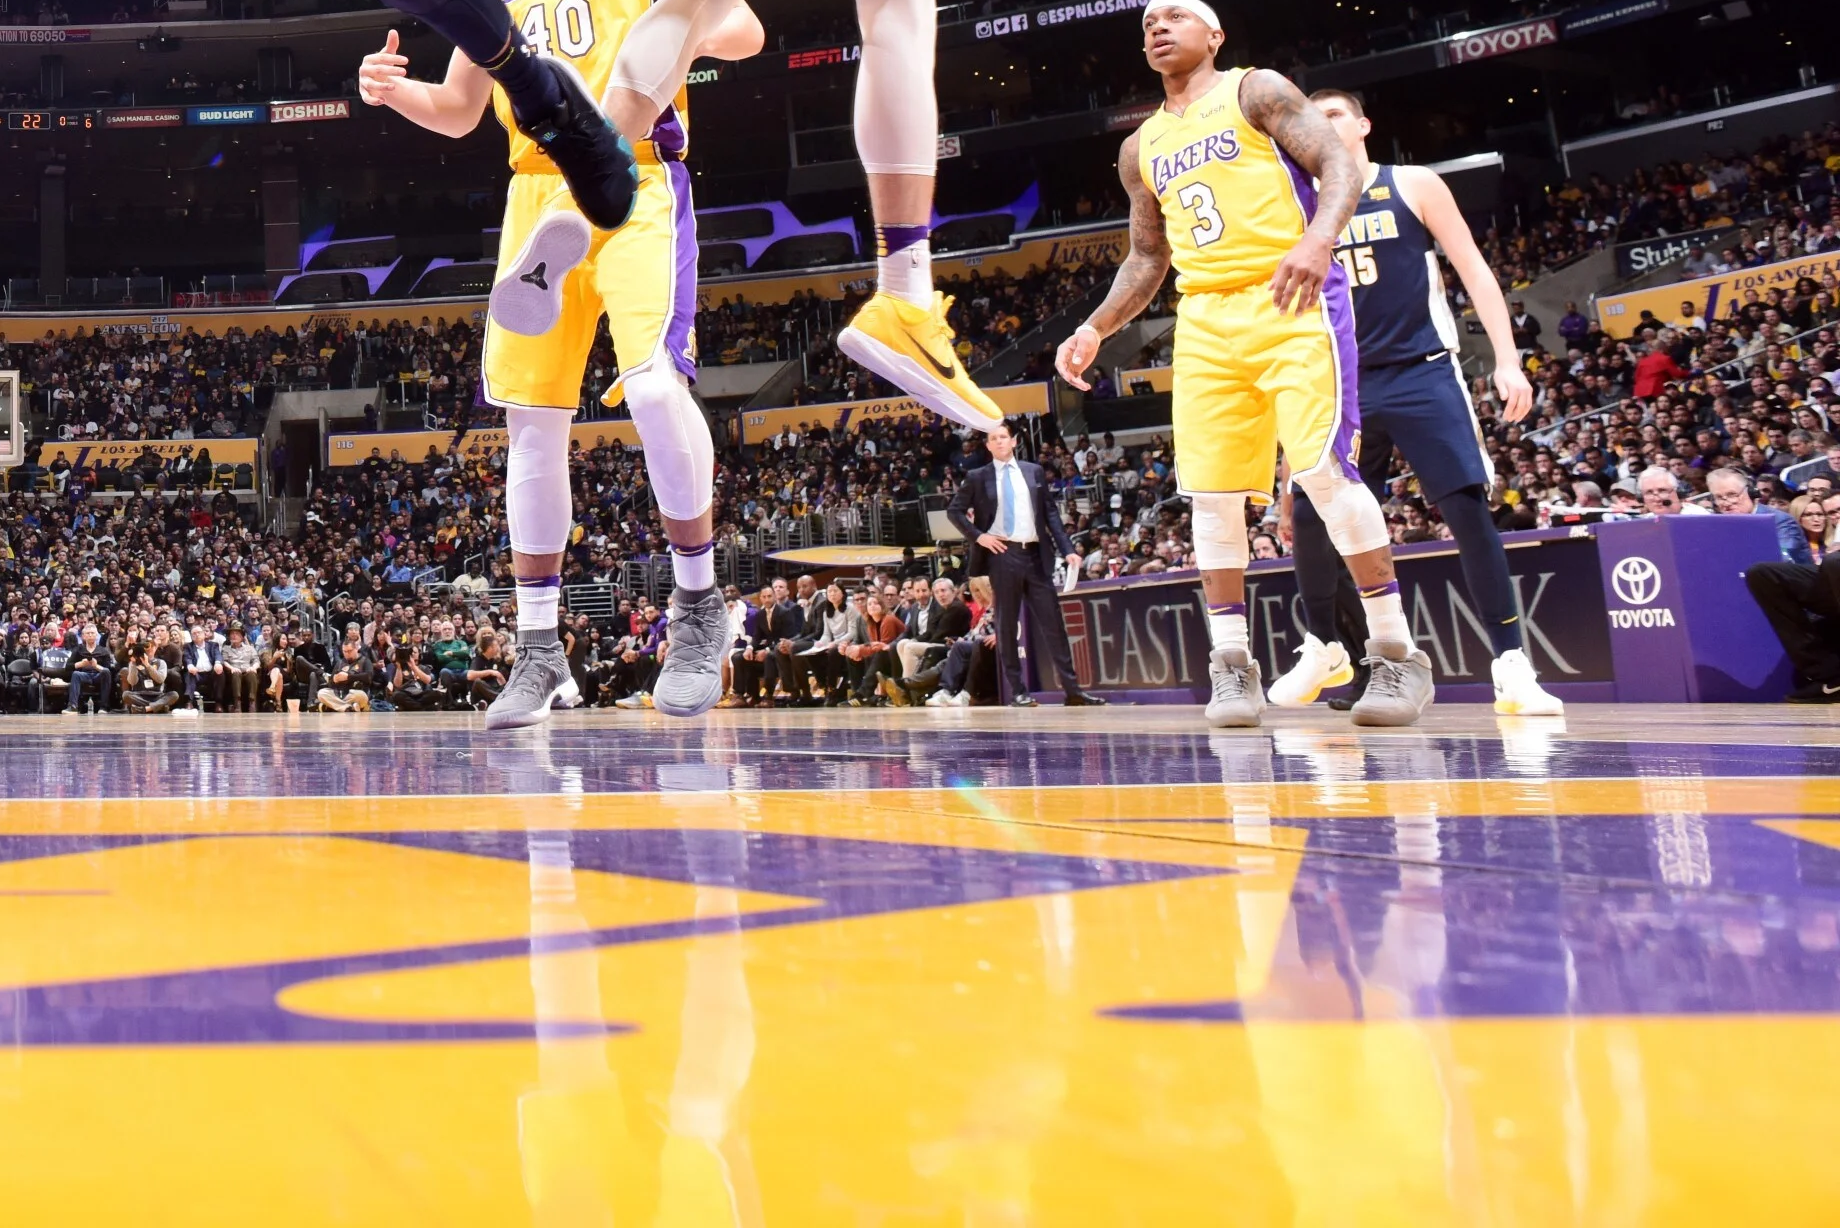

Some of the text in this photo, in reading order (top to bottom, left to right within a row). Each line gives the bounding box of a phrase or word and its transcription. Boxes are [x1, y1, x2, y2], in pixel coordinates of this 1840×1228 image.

[1565, 0, 1659, 31] AMERICAN EXPRESS
[19, 30, 28, 42] TO
[29, 30, 67, 42] 69050
[1449, 22, 1558, 64] TOYOTA
[111, 113, 180, 123] SAN MANUEL CASINO
[199, 109, 254, 120] BUD LIGHT
[271, 102, 348, 121] TOSHIBA
[22, 114, 41, 129] 22
[59, 116, 66, 127] 0
[85, 117, 92, 129] 6
[1150, 129, 1241, 197] LAKERS
[1177, 180, 1226, 249] 3
[1047, 241, 1123, 265] LAKERS
[1336, 245, 1379, 288] 15
[1734, 273, 1767, 291] LOS
[862, 403, 890, 415] LOS
[335, 439, 354, 449] 116
[473, 433, 499, 443] LOS
[100, 443, 124, 455] LOS
[1608, 607, 1676, 629] TOYOTA
[1088, 597, 1194, 685] EAST
[1410, 571, 1583, 677] ANK
